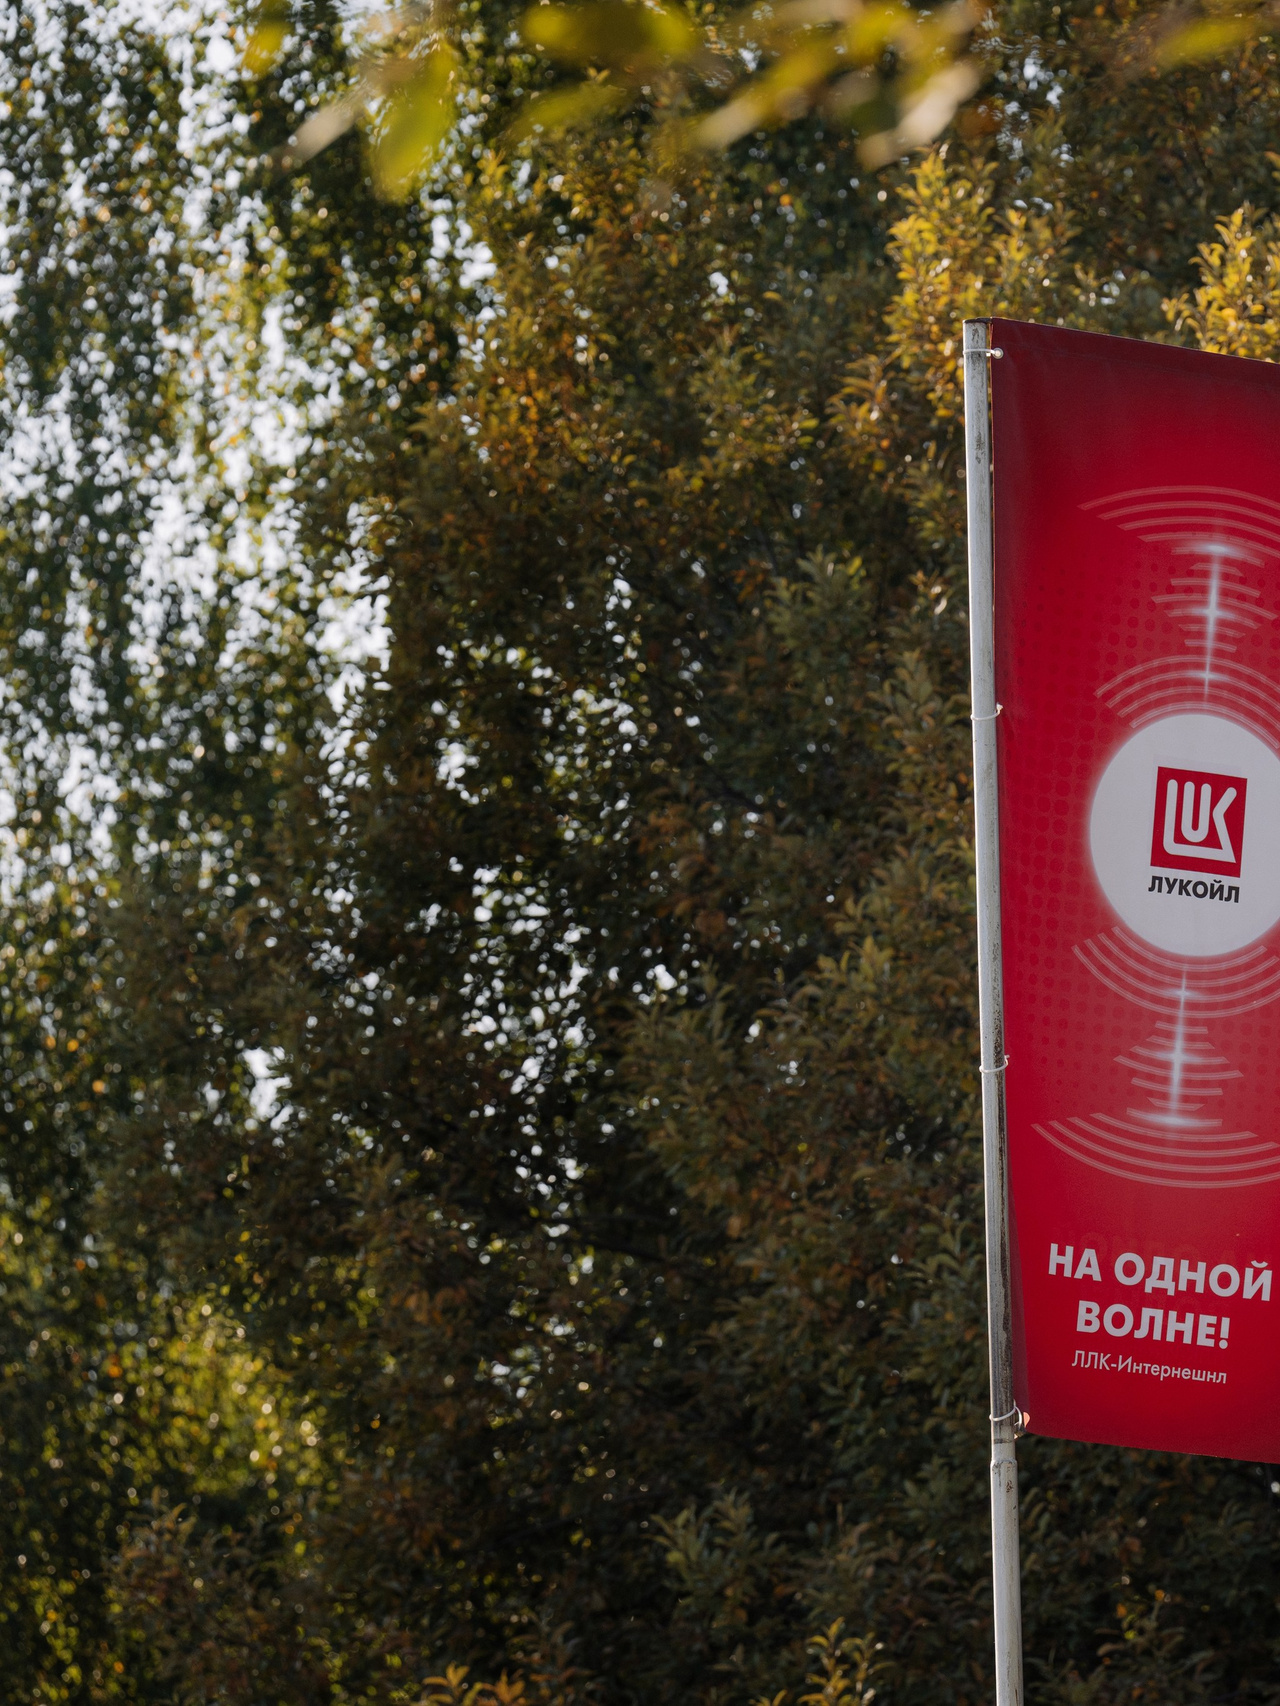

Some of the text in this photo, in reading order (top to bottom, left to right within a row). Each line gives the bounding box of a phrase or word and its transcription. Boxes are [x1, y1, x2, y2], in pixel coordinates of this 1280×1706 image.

[1148, 876, 1239, 903] ЛУКОЙЛ
[1048, 1243, 1273, 1302] НА ОДНОЙ
[1076, 1300, 1230, 1349] ВОЛНЕ!
[1071, 1350, 1227, 1384] ЛЛК-Интернешнл
